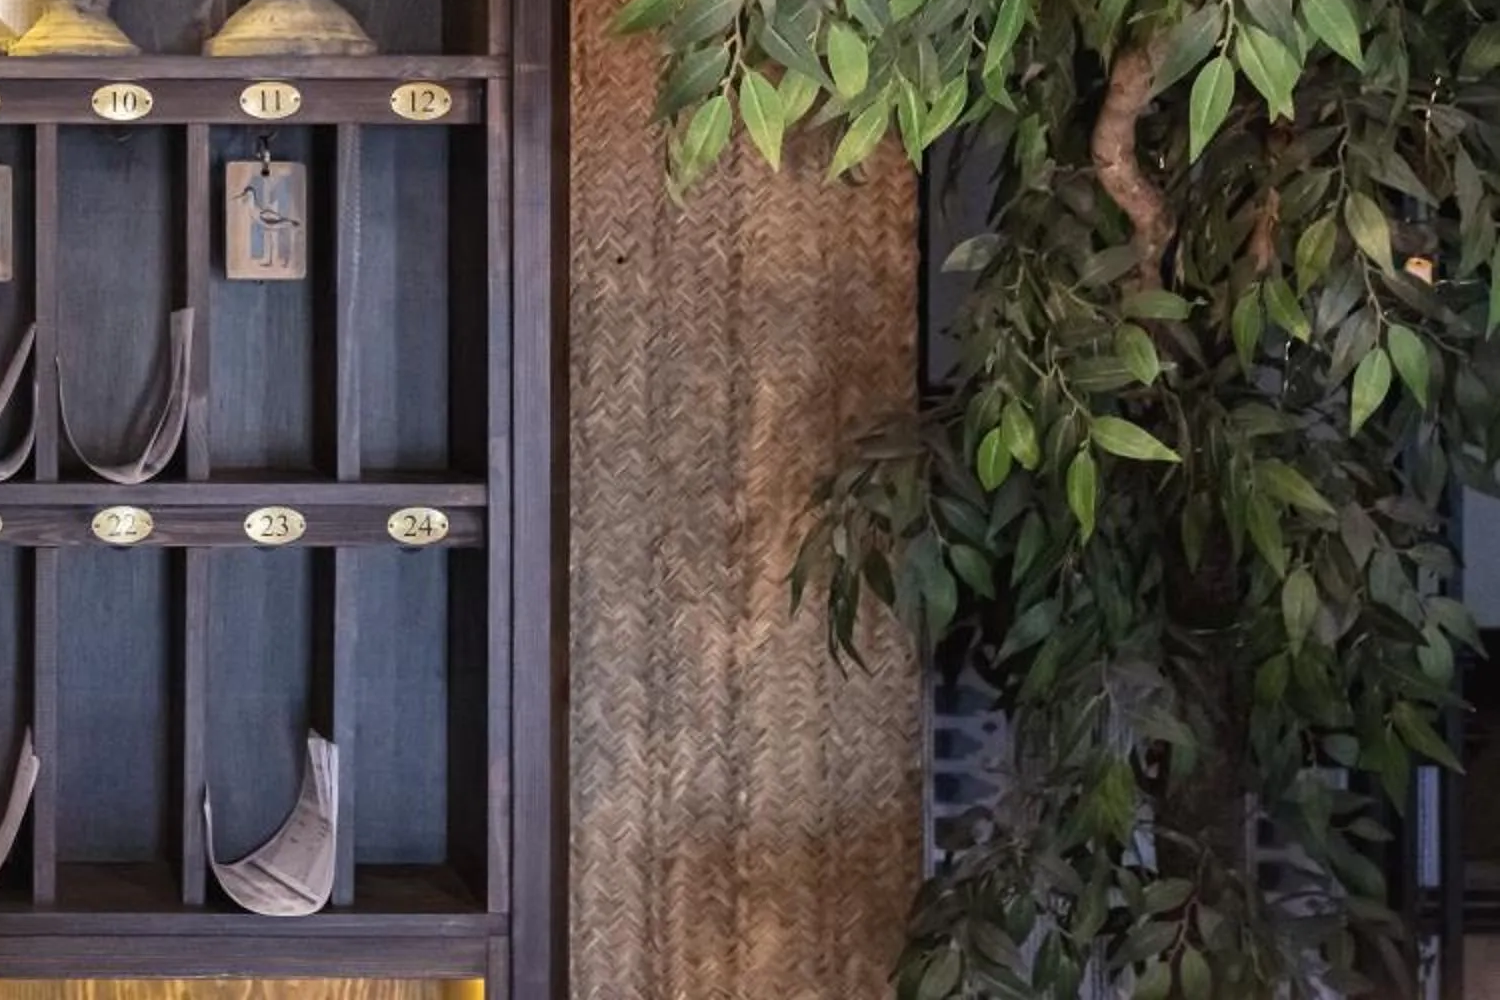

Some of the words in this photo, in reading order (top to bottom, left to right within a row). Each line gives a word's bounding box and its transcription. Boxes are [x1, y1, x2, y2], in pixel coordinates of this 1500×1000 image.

[110, 91, 137, 113] 10
[259, 90, 281, 112] 11
[410, 90, 435, 113] 12
[108, 515, 137, 535] 22
[261, 516, 290, 536] 23
[404, 516, 432, 537] 24
